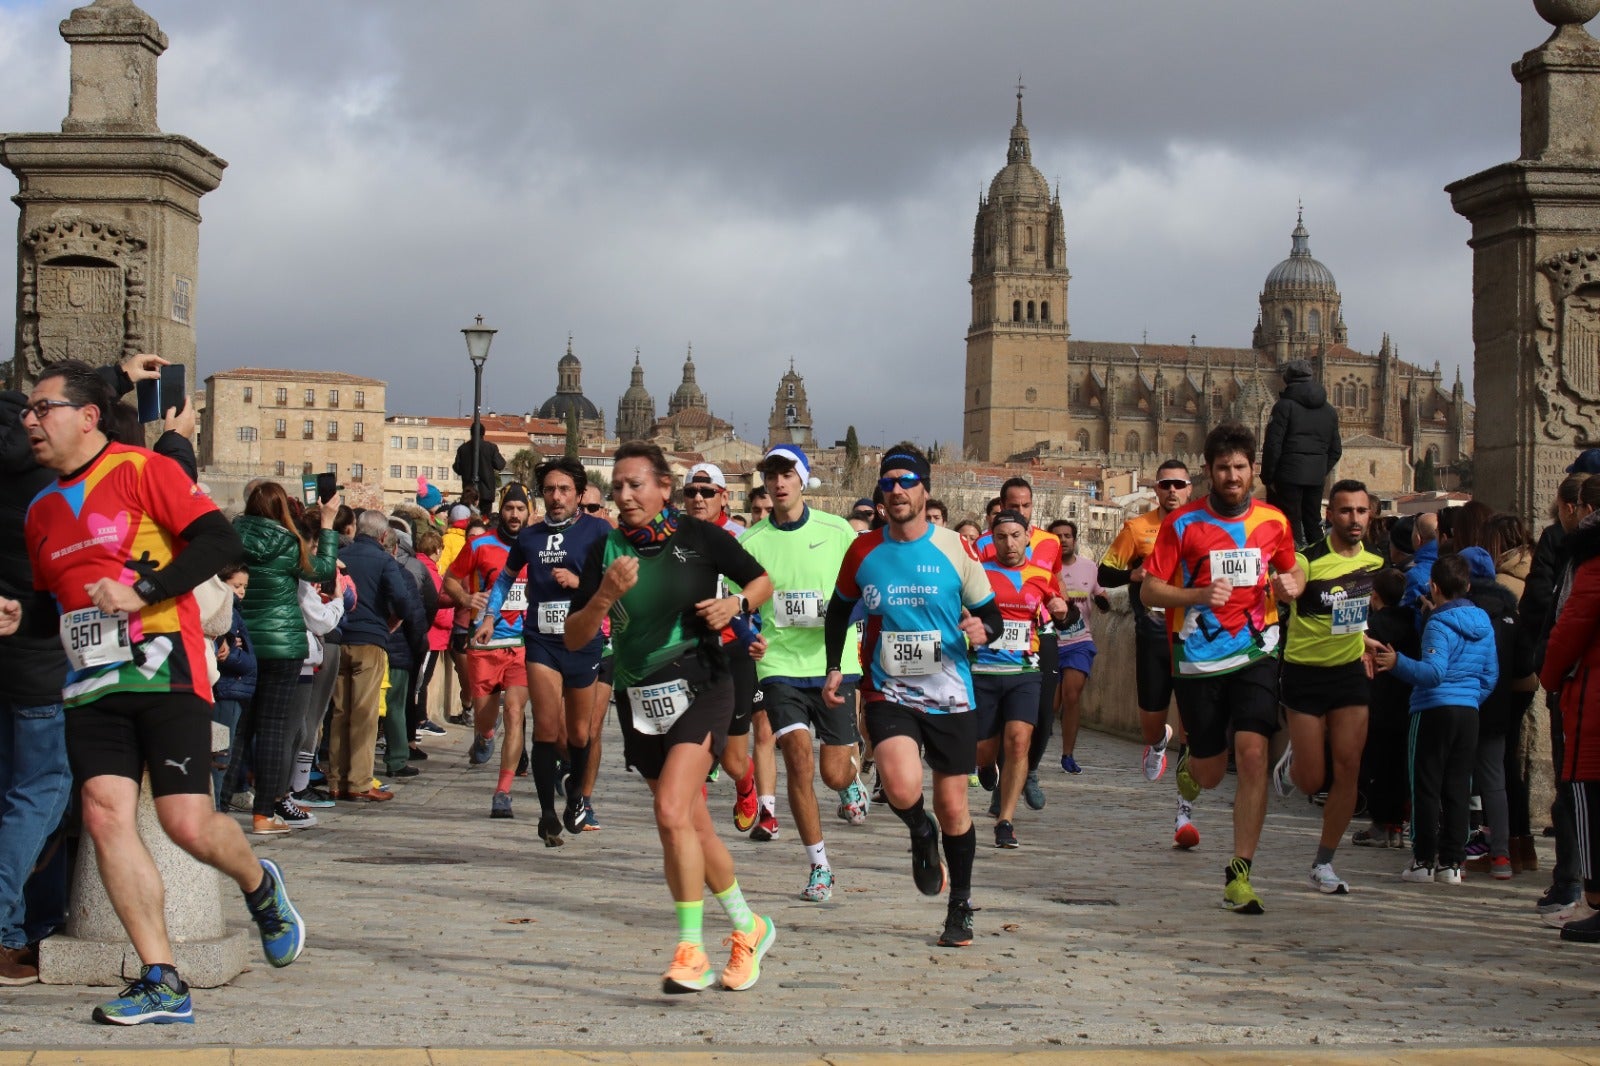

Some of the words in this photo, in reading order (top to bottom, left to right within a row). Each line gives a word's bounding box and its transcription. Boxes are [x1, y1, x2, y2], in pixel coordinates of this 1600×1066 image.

[546, 533, 564, 550] R
[541, 556, 563, 564] HEART
[1222, 559, 1247, 575] 1041
[507, 591, 521, 601] 88
[887, 584, 938, 594] Giménez
[785, 600, 805, 615] 841
[1338, 607, 1363, 623] 3474
[545, 610, 566, 623] 663
[71, 623, 102, 650] 950
[896, 634, 935, 642] SETEL
[894, 643, 922, 661] 394
[642, 683, 685, 698] SETEL
[642, 697, 675, 718] 909
